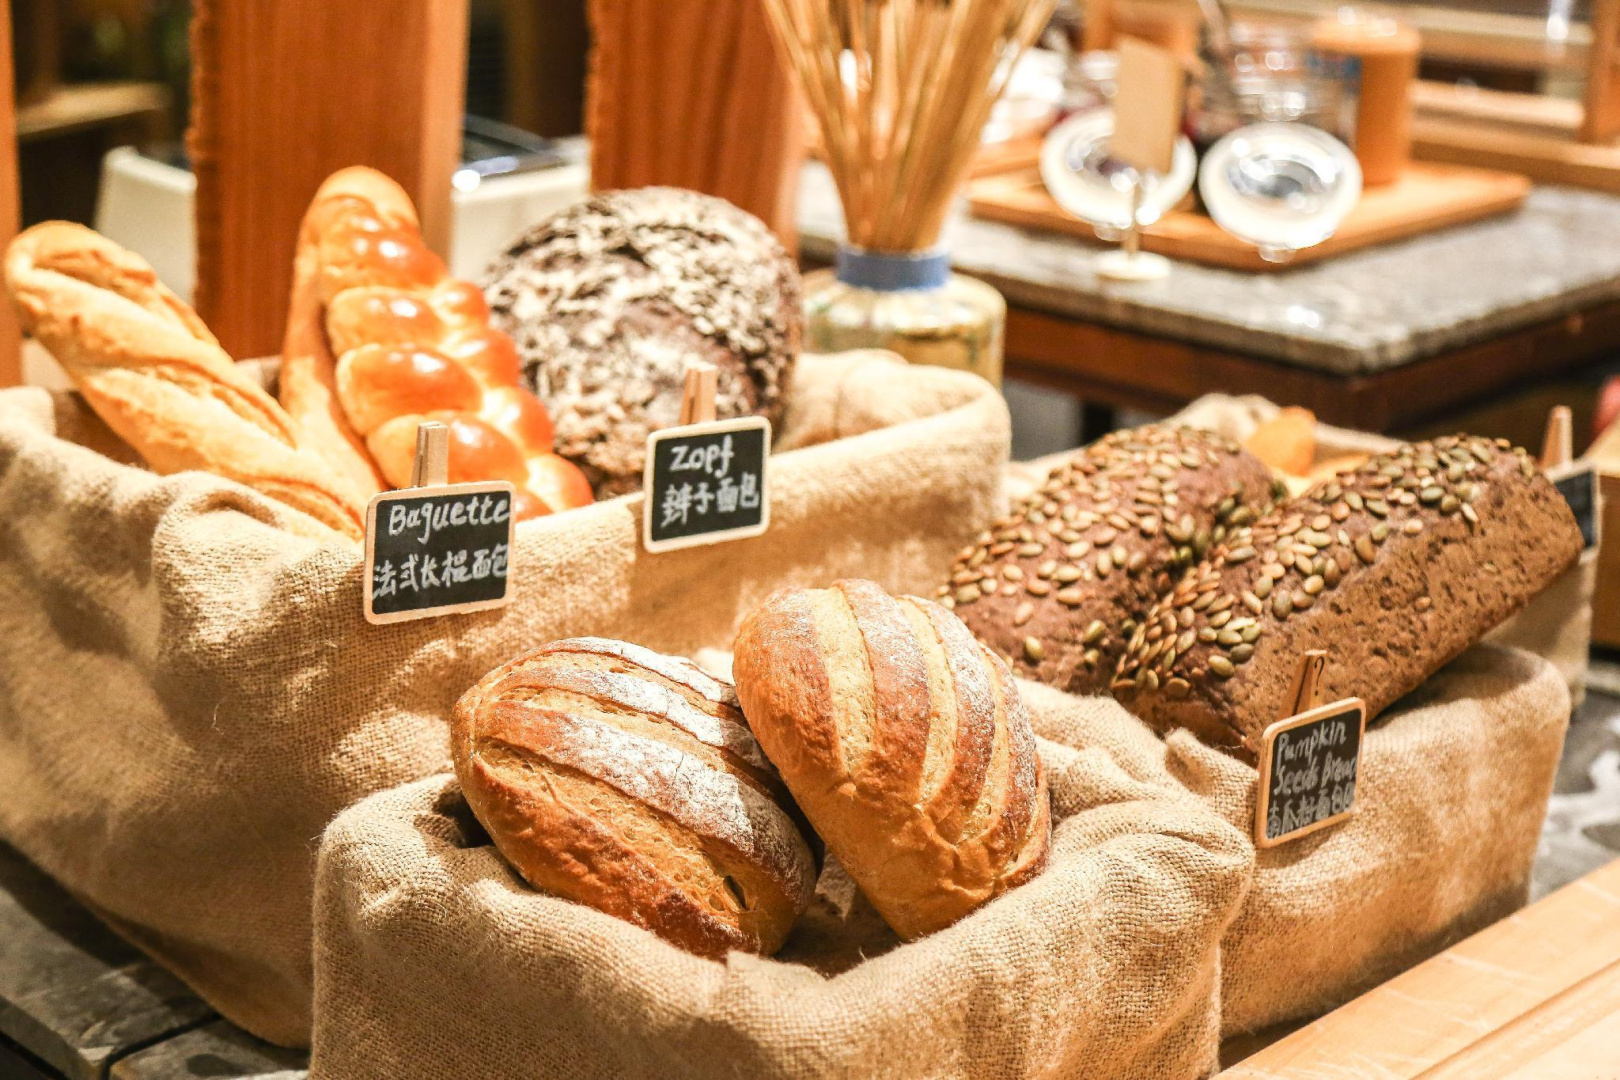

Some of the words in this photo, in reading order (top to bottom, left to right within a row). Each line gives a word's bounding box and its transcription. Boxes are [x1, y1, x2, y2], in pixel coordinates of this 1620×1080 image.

[669, 434, 735, 479] Zopf
[388, 495, 510, 545] Baguette
[372, 543, 509, 600] 法式长棍面包
[1314, 656, 1325, 696] ?
[1276, 721, 1347, 776] Pumpkin
